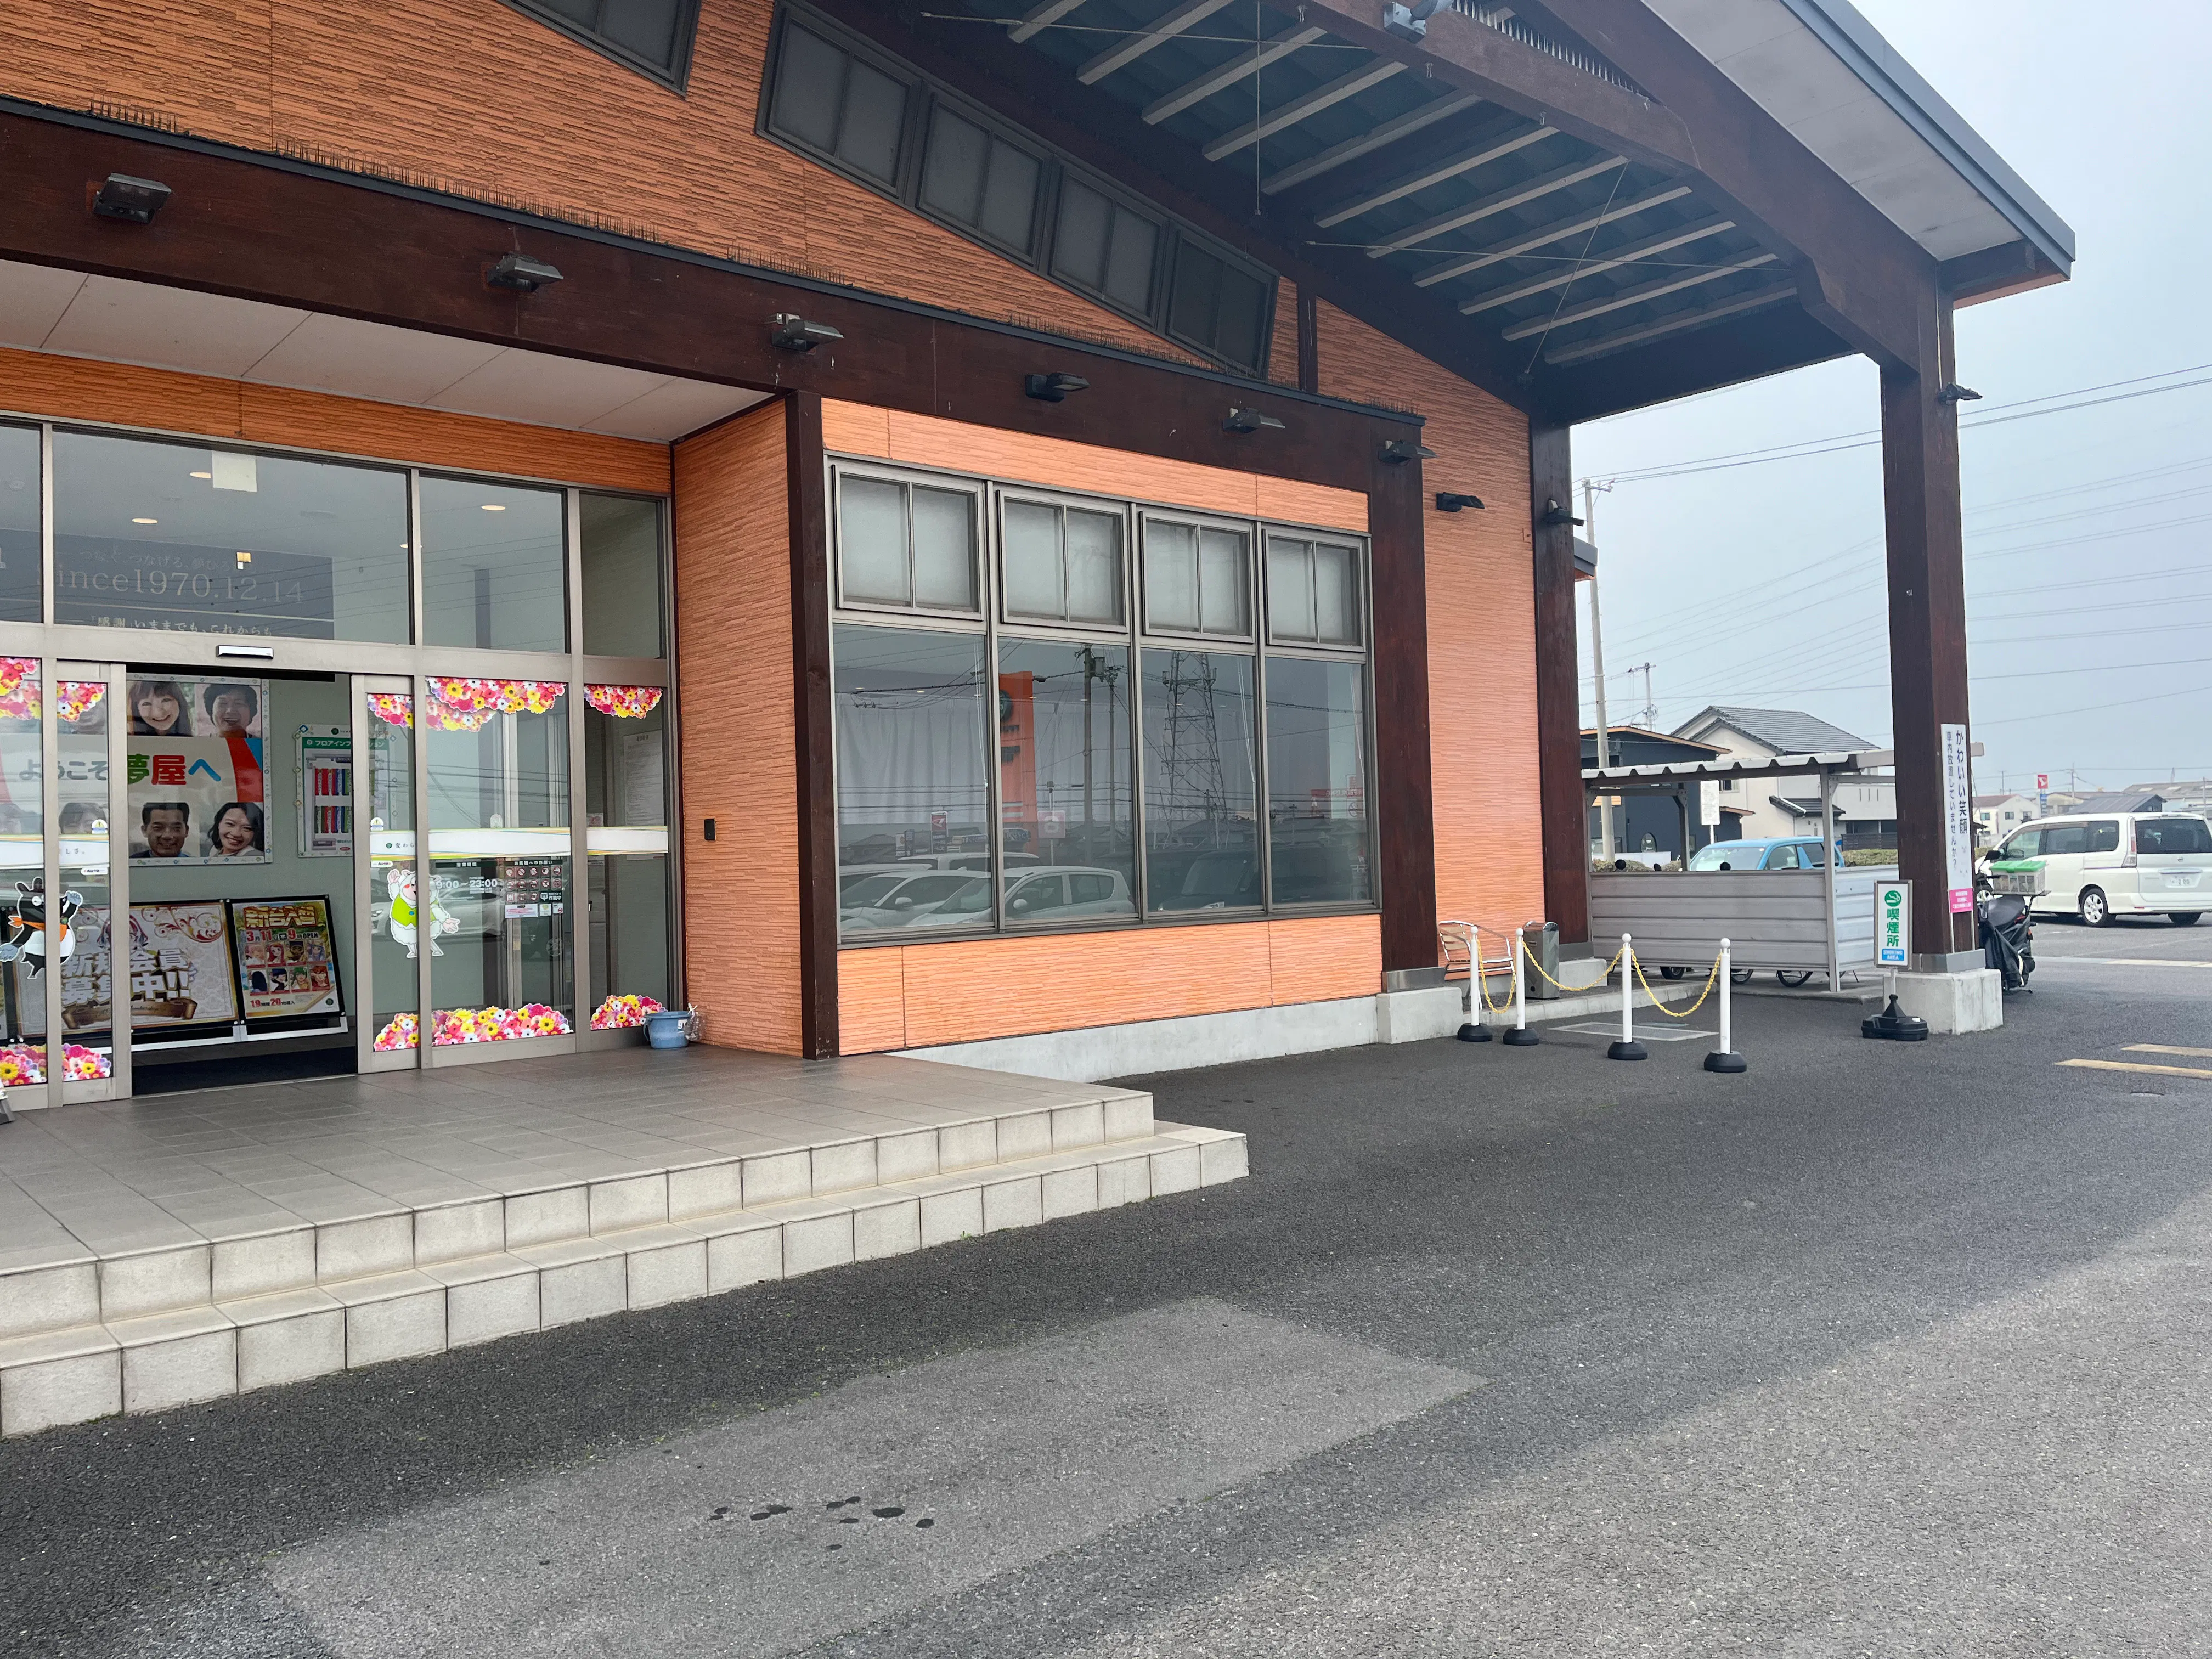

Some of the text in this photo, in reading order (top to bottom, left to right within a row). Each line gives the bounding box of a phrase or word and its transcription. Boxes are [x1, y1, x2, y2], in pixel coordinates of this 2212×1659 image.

[1956, 730, 1968, 834] かわいい笑顔
[1887, 908, 1900, 947] 喫煙所
